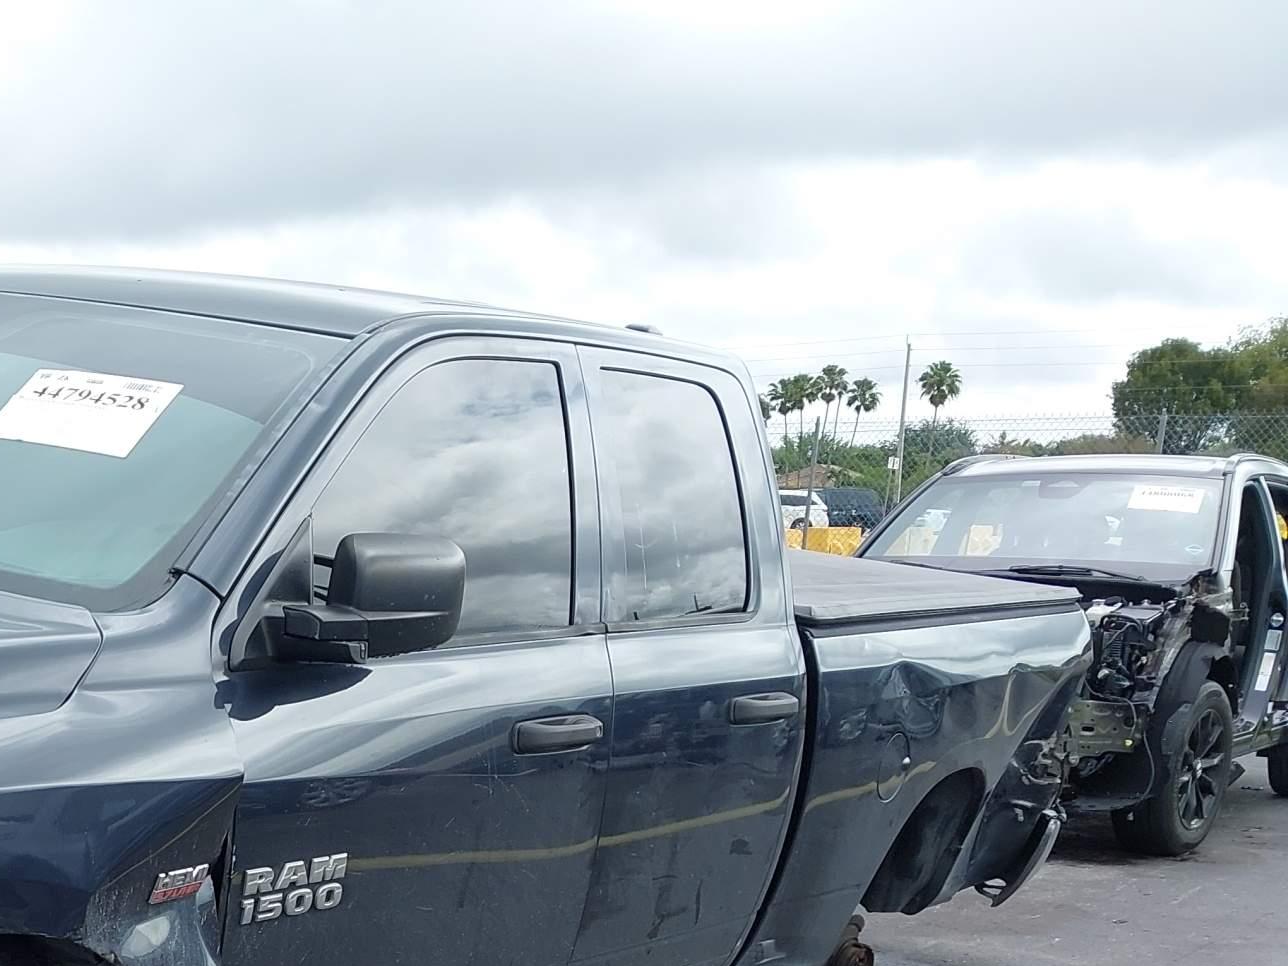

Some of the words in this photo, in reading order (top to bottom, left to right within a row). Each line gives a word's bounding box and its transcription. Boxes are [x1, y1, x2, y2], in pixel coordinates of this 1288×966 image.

[33, 385, 150, 410] 44794528
[244, 853, 349, 896] RAM
[240, 882, 344, 925] 1500
